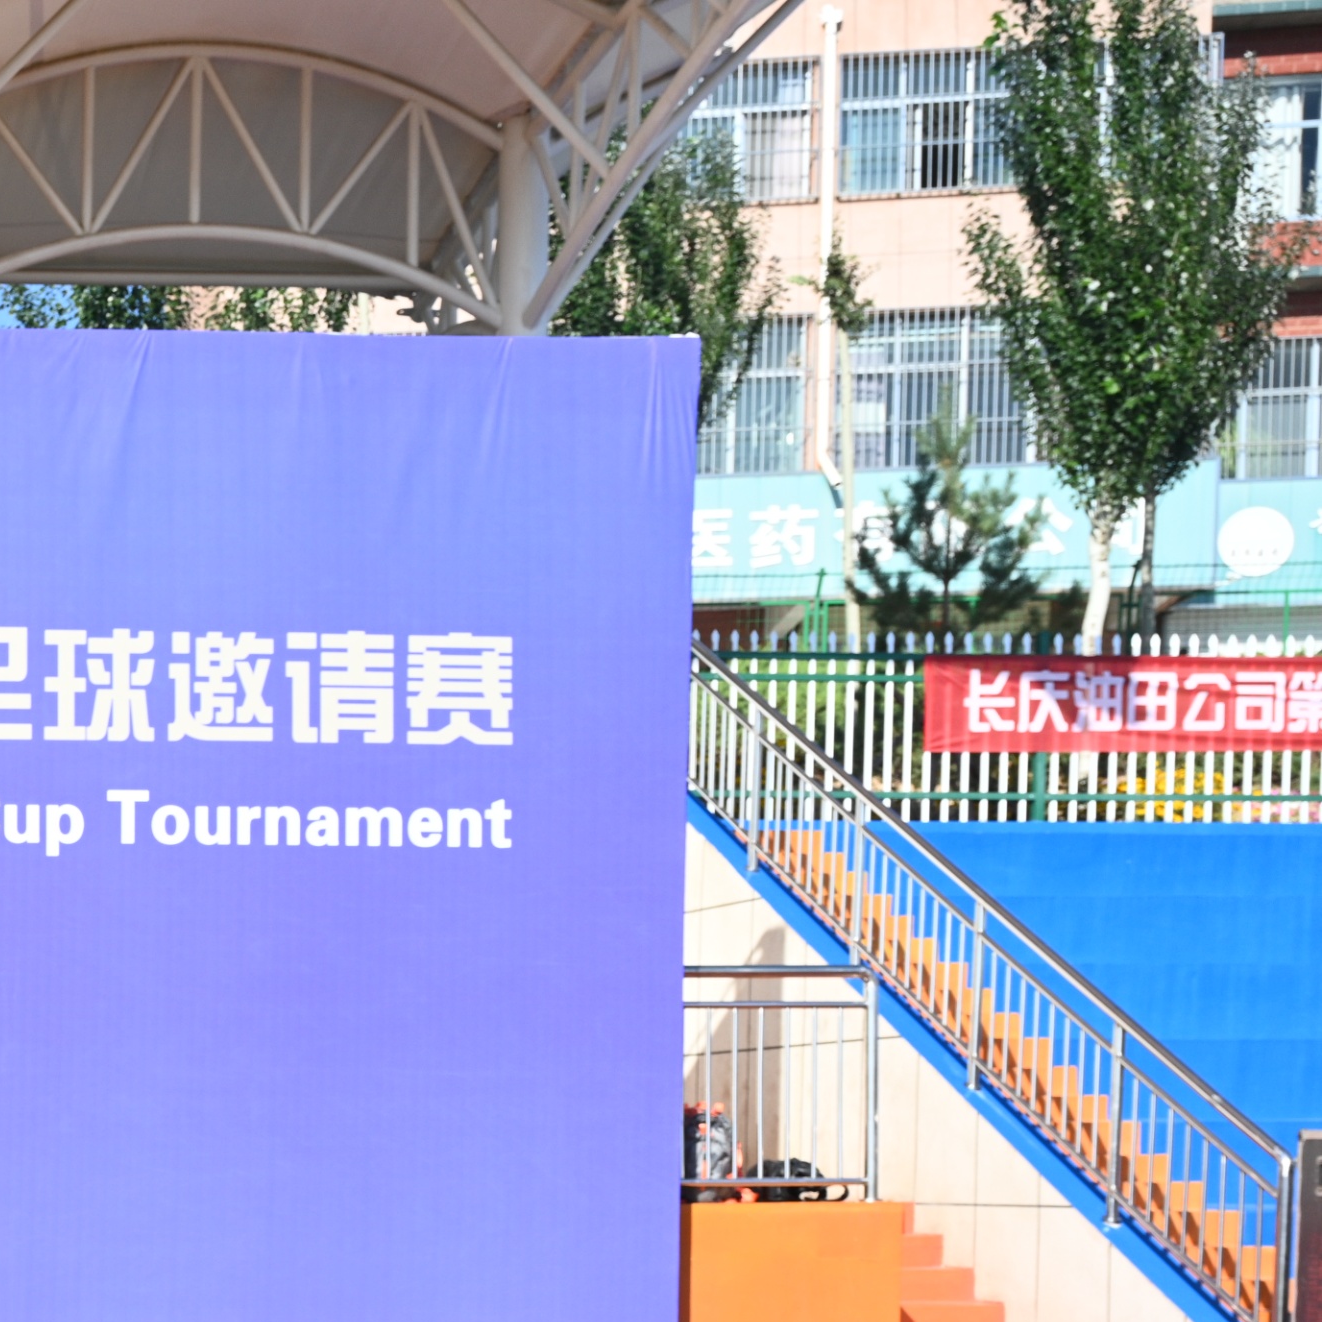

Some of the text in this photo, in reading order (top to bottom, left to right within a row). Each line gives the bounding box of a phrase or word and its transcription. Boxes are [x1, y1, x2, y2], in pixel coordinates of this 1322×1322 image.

[963, 668, 1322, 733] 长庆油田公司第
[106, 789, 513, 849] Tournament
